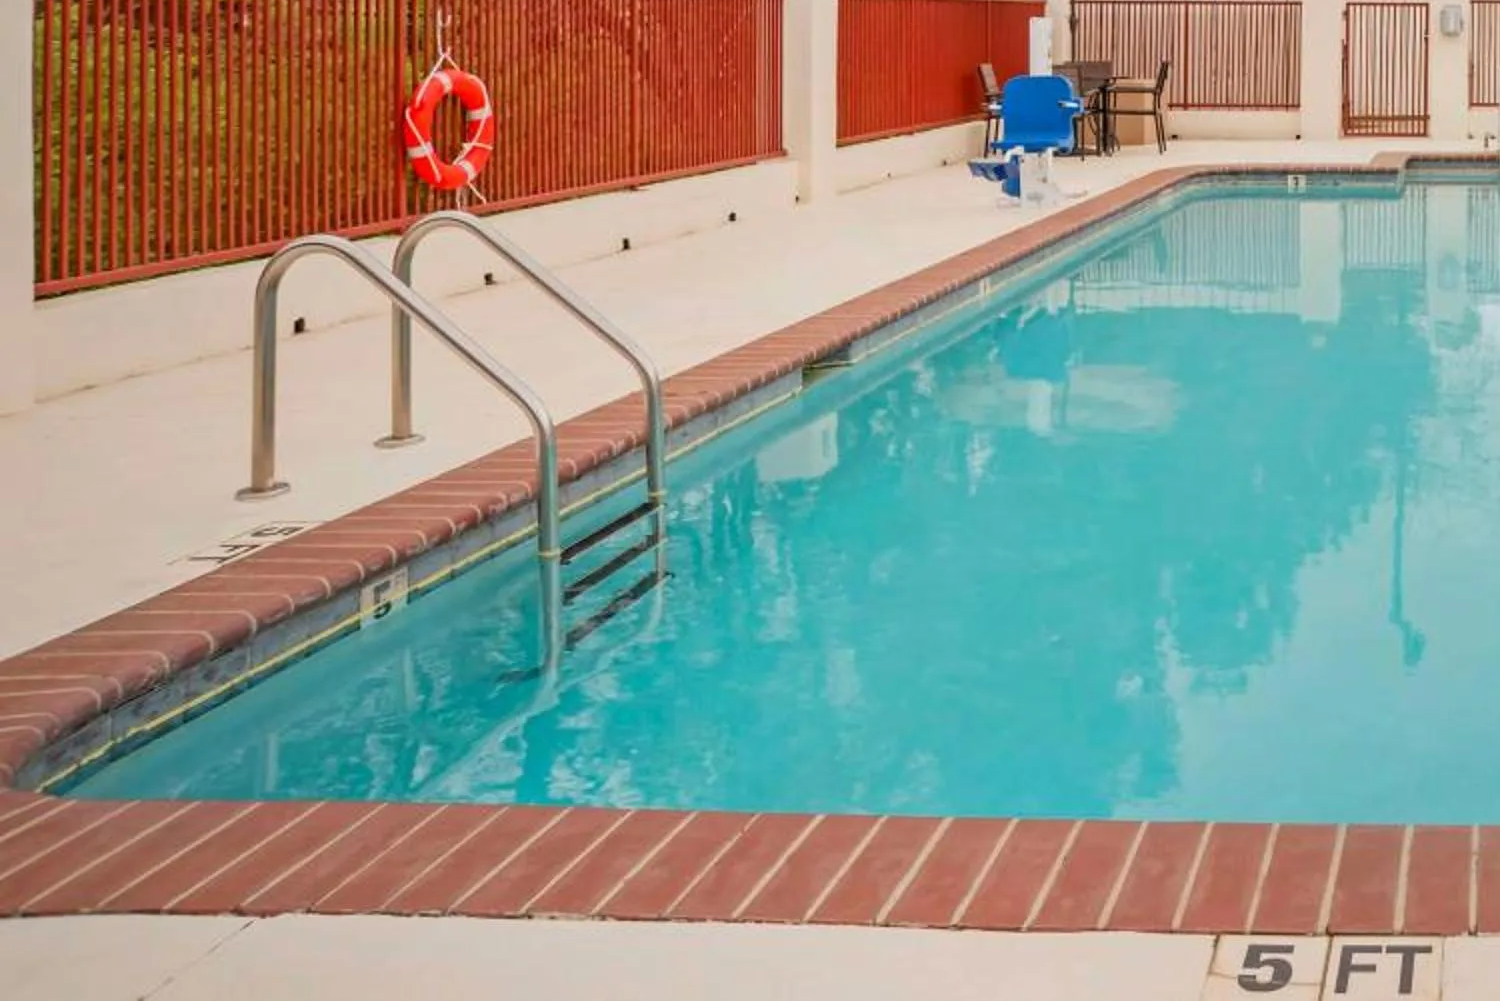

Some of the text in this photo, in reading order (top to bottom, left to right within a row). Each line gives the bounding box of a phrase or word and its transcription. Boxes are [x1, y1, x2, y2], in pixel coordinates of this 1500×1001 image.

[373, 580, 392, 620] 5
[1237, 944, 1433, 995] 5 FT
